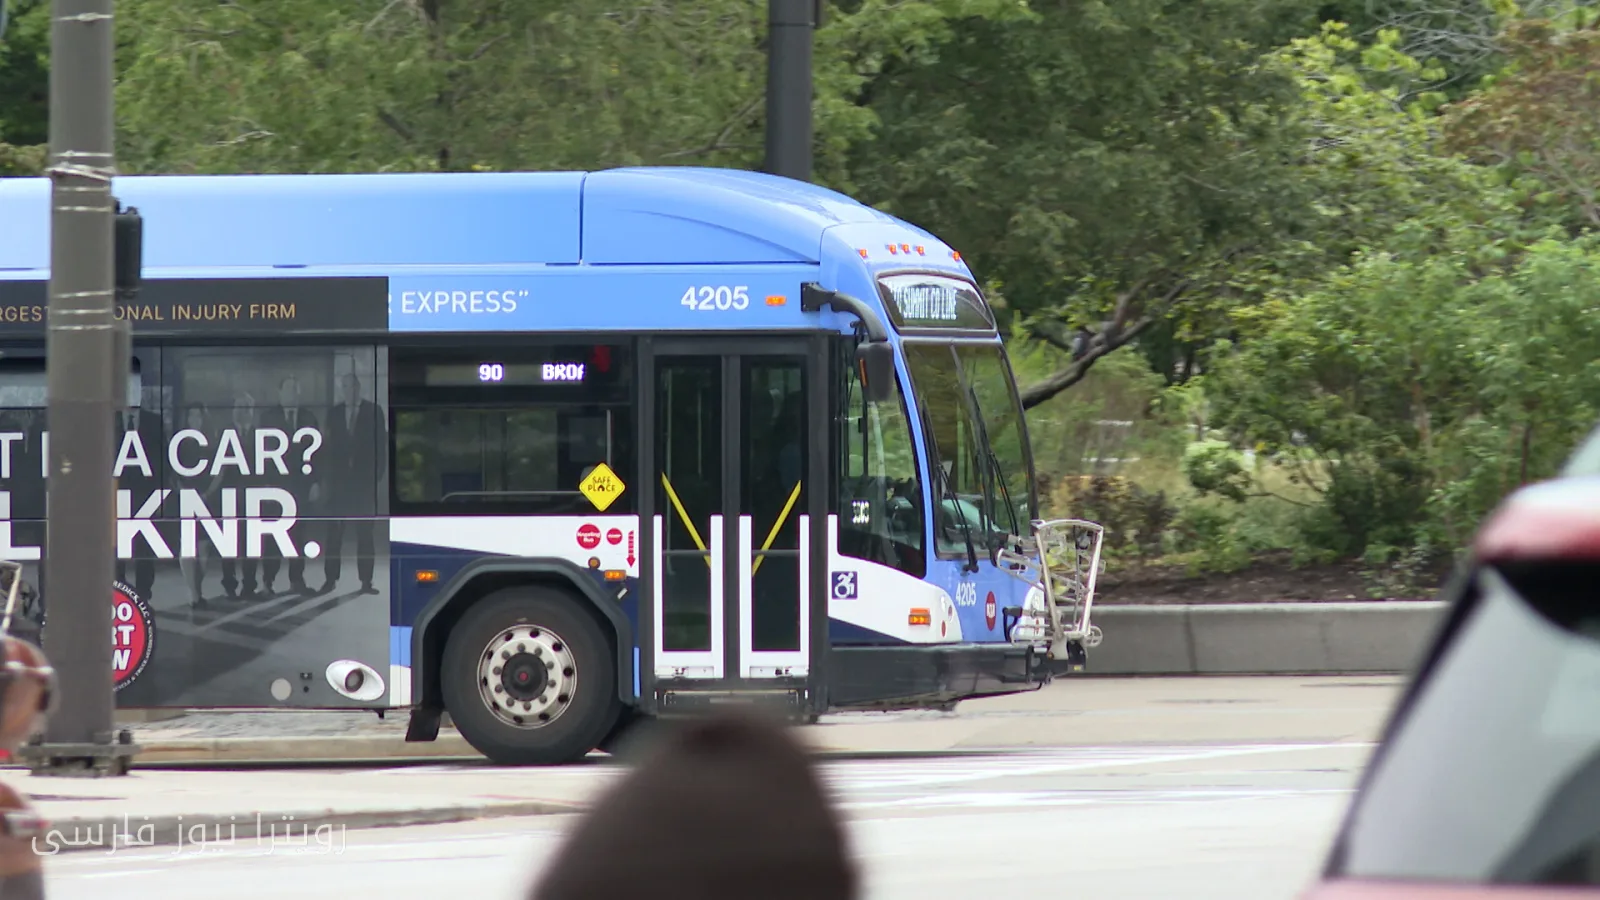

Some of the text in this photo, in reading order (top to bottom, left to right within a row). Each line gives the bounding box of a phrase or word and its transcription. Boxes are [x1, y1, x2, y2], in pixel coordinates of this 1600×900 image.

[681, 286, 749, 311] 4205
[903, 287, 929, 319] SUMMIT
[931, 287, 940, 319] CO
[941, 288, 957, 320] LINE
[172, 304, 242, 320] INJURY
[250, 303, 296, 319] FIRM
[479, 363, 503, 381] 90
[112, 430, 153, 478] A
[168, 427, 322, 477] CAR?
[592, 476, 611, 484] SAFE
[116, 487, 321, 560] KNR.
[955, 582, 977, 607] 4205
